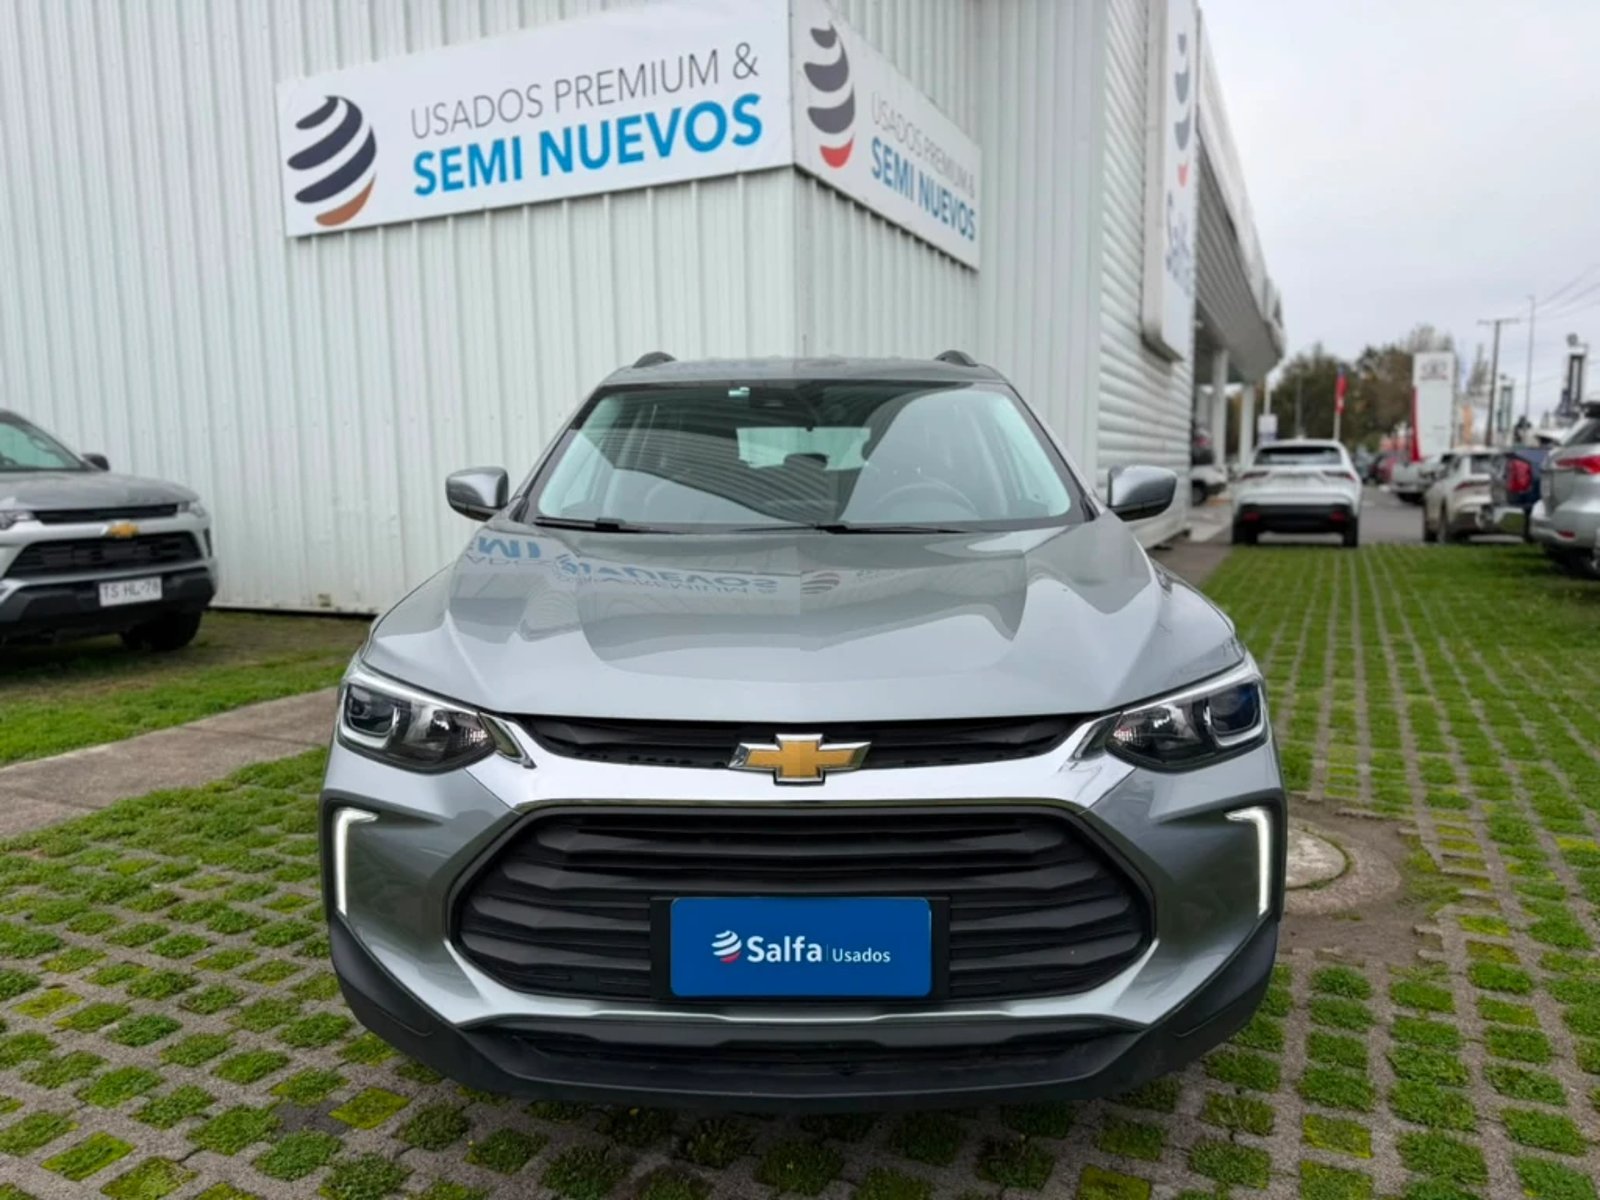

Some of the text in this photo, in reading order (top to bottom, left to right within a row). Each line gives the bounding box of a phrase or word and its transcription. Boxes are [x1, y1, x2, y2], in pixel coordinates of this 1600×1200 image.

[411, 42, 759, 139] USADOS PREMIUM &
[871, 91, 922, 157] USADOS
[413, 93, 763, 196] SEMI NUEVOS
[871, 136, 976, 242] SEMI NUEVOS
[746, 935, 892, 963] Salfa Usados
